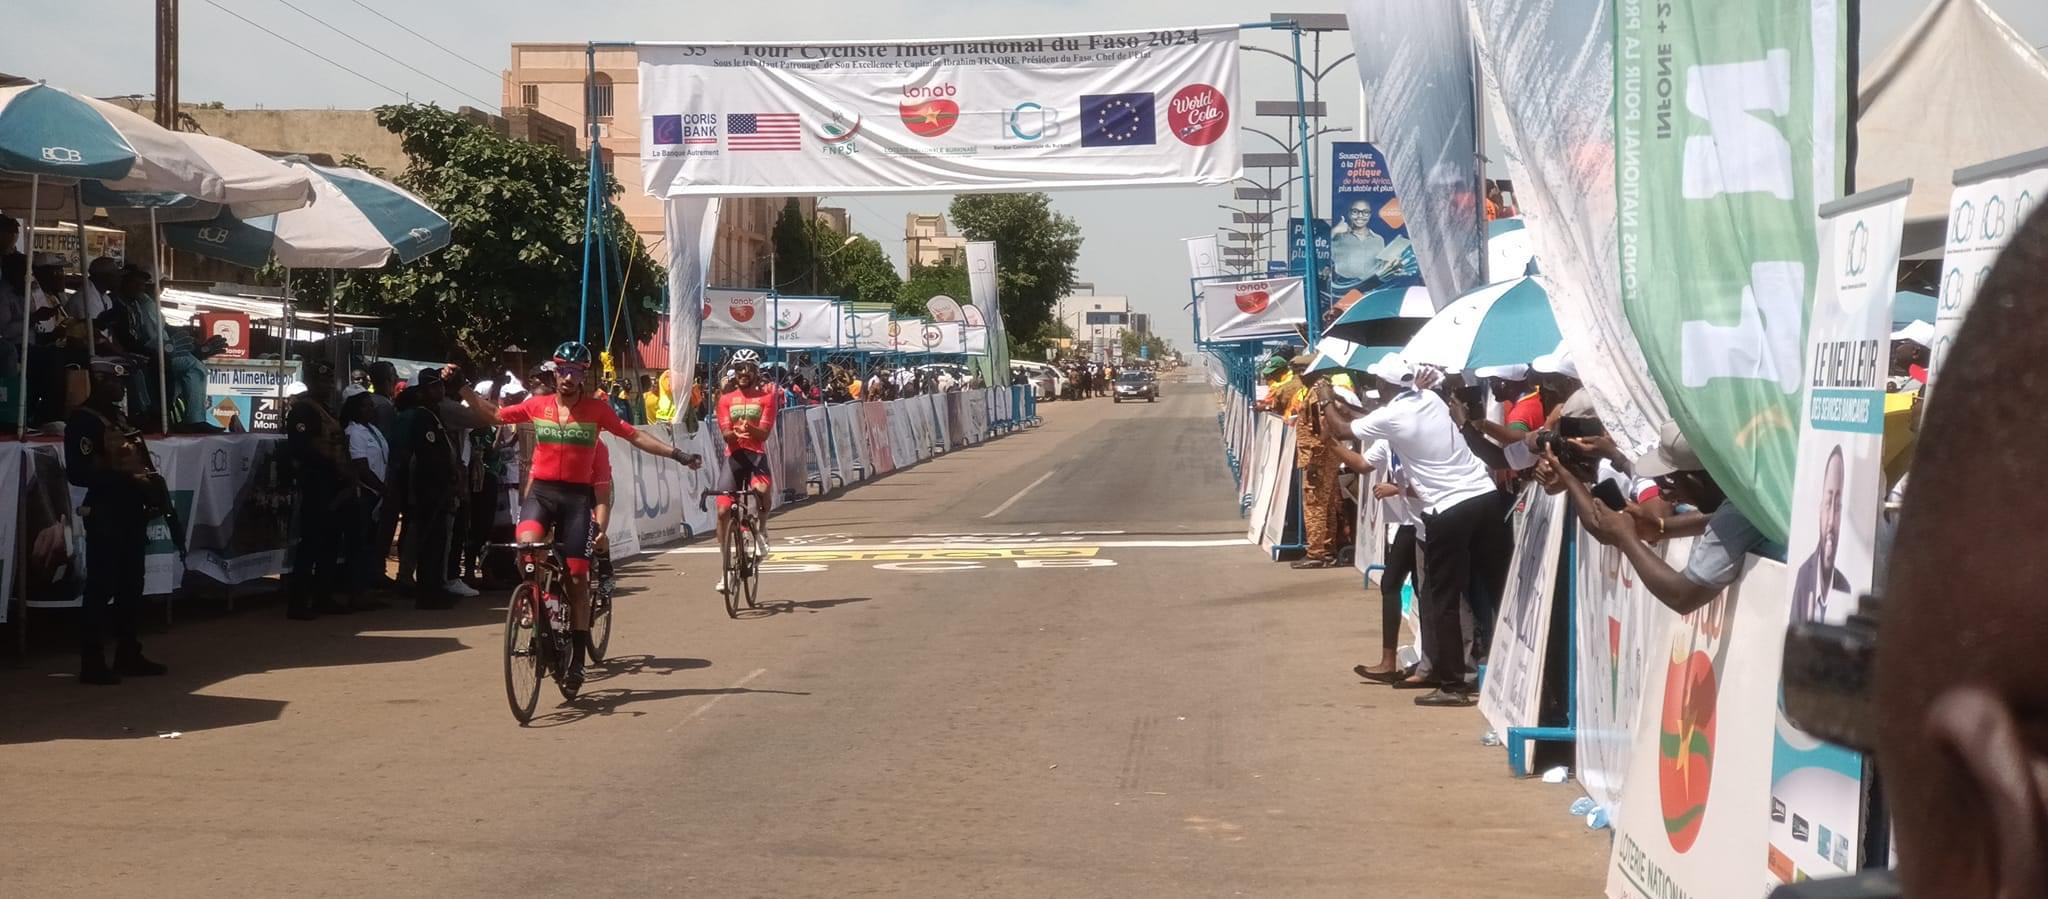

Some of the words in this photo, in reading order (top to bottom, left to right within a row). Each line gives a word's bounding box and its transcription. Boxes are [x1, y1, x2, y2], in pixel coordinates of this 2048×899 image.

[743, 45, 794, 58] Tour
[800, 45, 887, 62] Cycliste
[896, 38, 1043, 58] International
[1051, 36, 1079, 51] du
[1089, 34, 1140, 50] Faso
[1149, 28, 1200, 47] 2024
[713, 58, 732, 67] Sous
[823, 61, 833, 70] de
[835, 61, 850, 70] Son
[1021, 54, 1059, 64] Président
[1060, 54, 1071, 63] du
[1096, 51, 1115, 61] Chef
[902, 82, 957, 98] lonab
[1173, 89, 1213, 114] World
[684, 113, 717, 125] CORIS
[1002, 102, 1061, 141] BCB
[1188, 105, 1223, 125] Cola
[684, 126, 717, 137] BANK
[42, 147, 82, 162] BCB
[662, 149, 686, 158] Banque
[687, 148, 719, 157] Autrement
[1354, 159, 1376, 169] fibre
[1347, 169, 1382, 178] optique
[1338, 185, 1352, 193] plus
[226, 347, 246, 356] oney
[1826, 339, 1879, 388] MEILLEUR
[210, 369, 230, 384] Mini
[1619, 829, 1646, 883] LOTERIE
